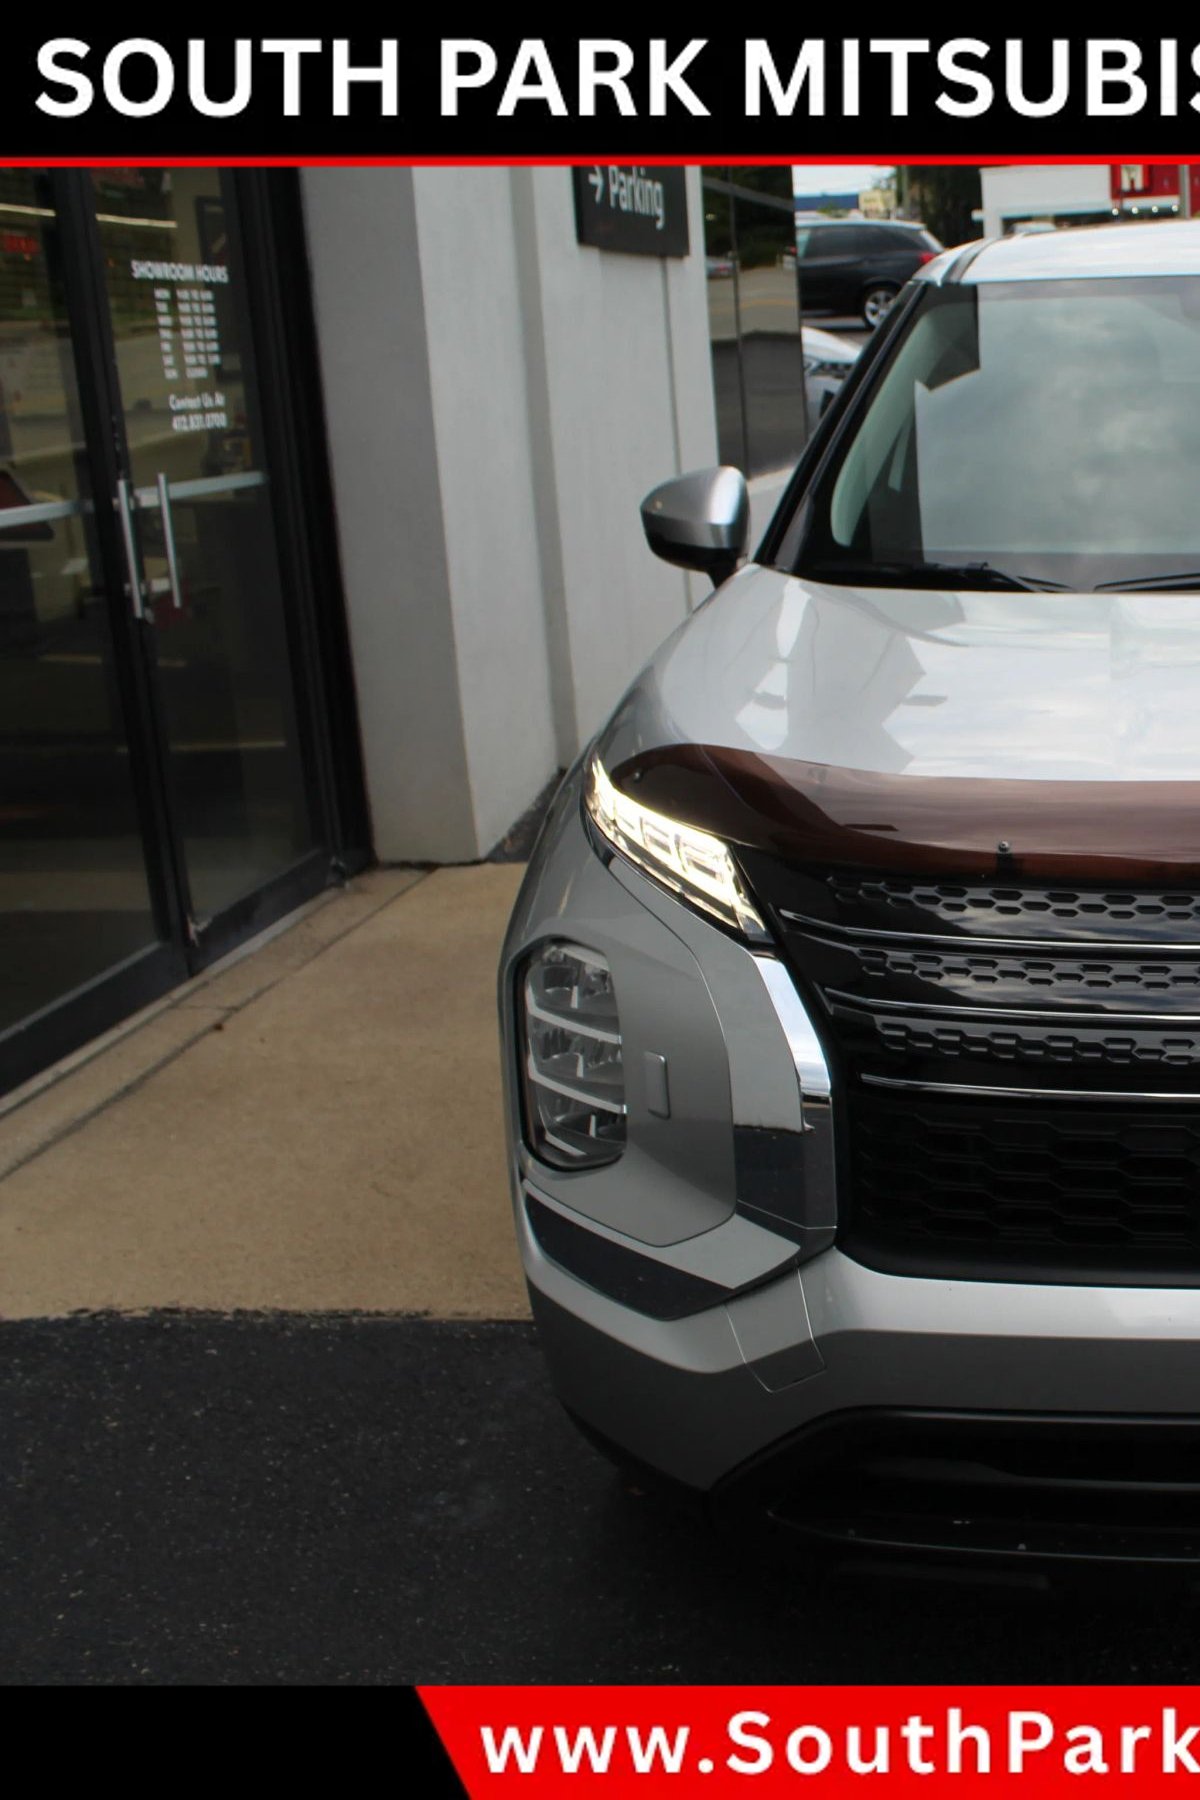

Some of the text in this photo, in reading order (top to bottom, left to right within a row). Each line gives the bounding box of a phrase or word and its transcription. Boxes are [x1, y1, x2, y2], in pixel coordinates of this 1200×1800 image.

[608, 165, 665, 230] Parking
[131, 260, 229, 283] SHOWROOM HOURS
